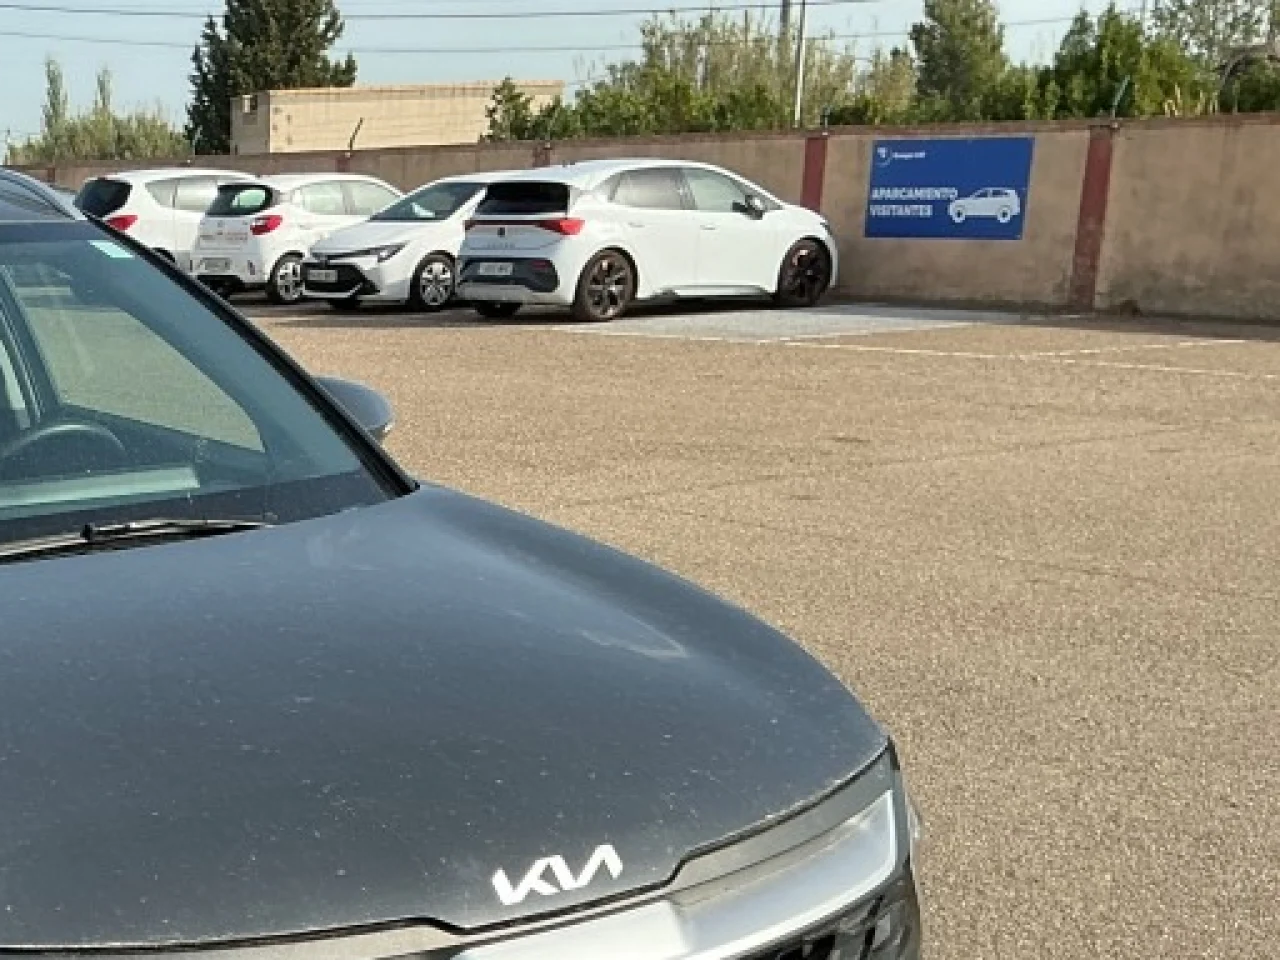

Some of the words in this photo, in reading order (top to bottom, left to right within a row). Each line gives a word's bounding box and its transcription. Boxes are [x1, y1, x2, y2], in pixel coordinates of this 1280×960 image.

[872, 187, 959, 201] APARCAMIENTO
[869, 204, 933, 218] VISITANTES
[492, 844, 623, 905] KIA
